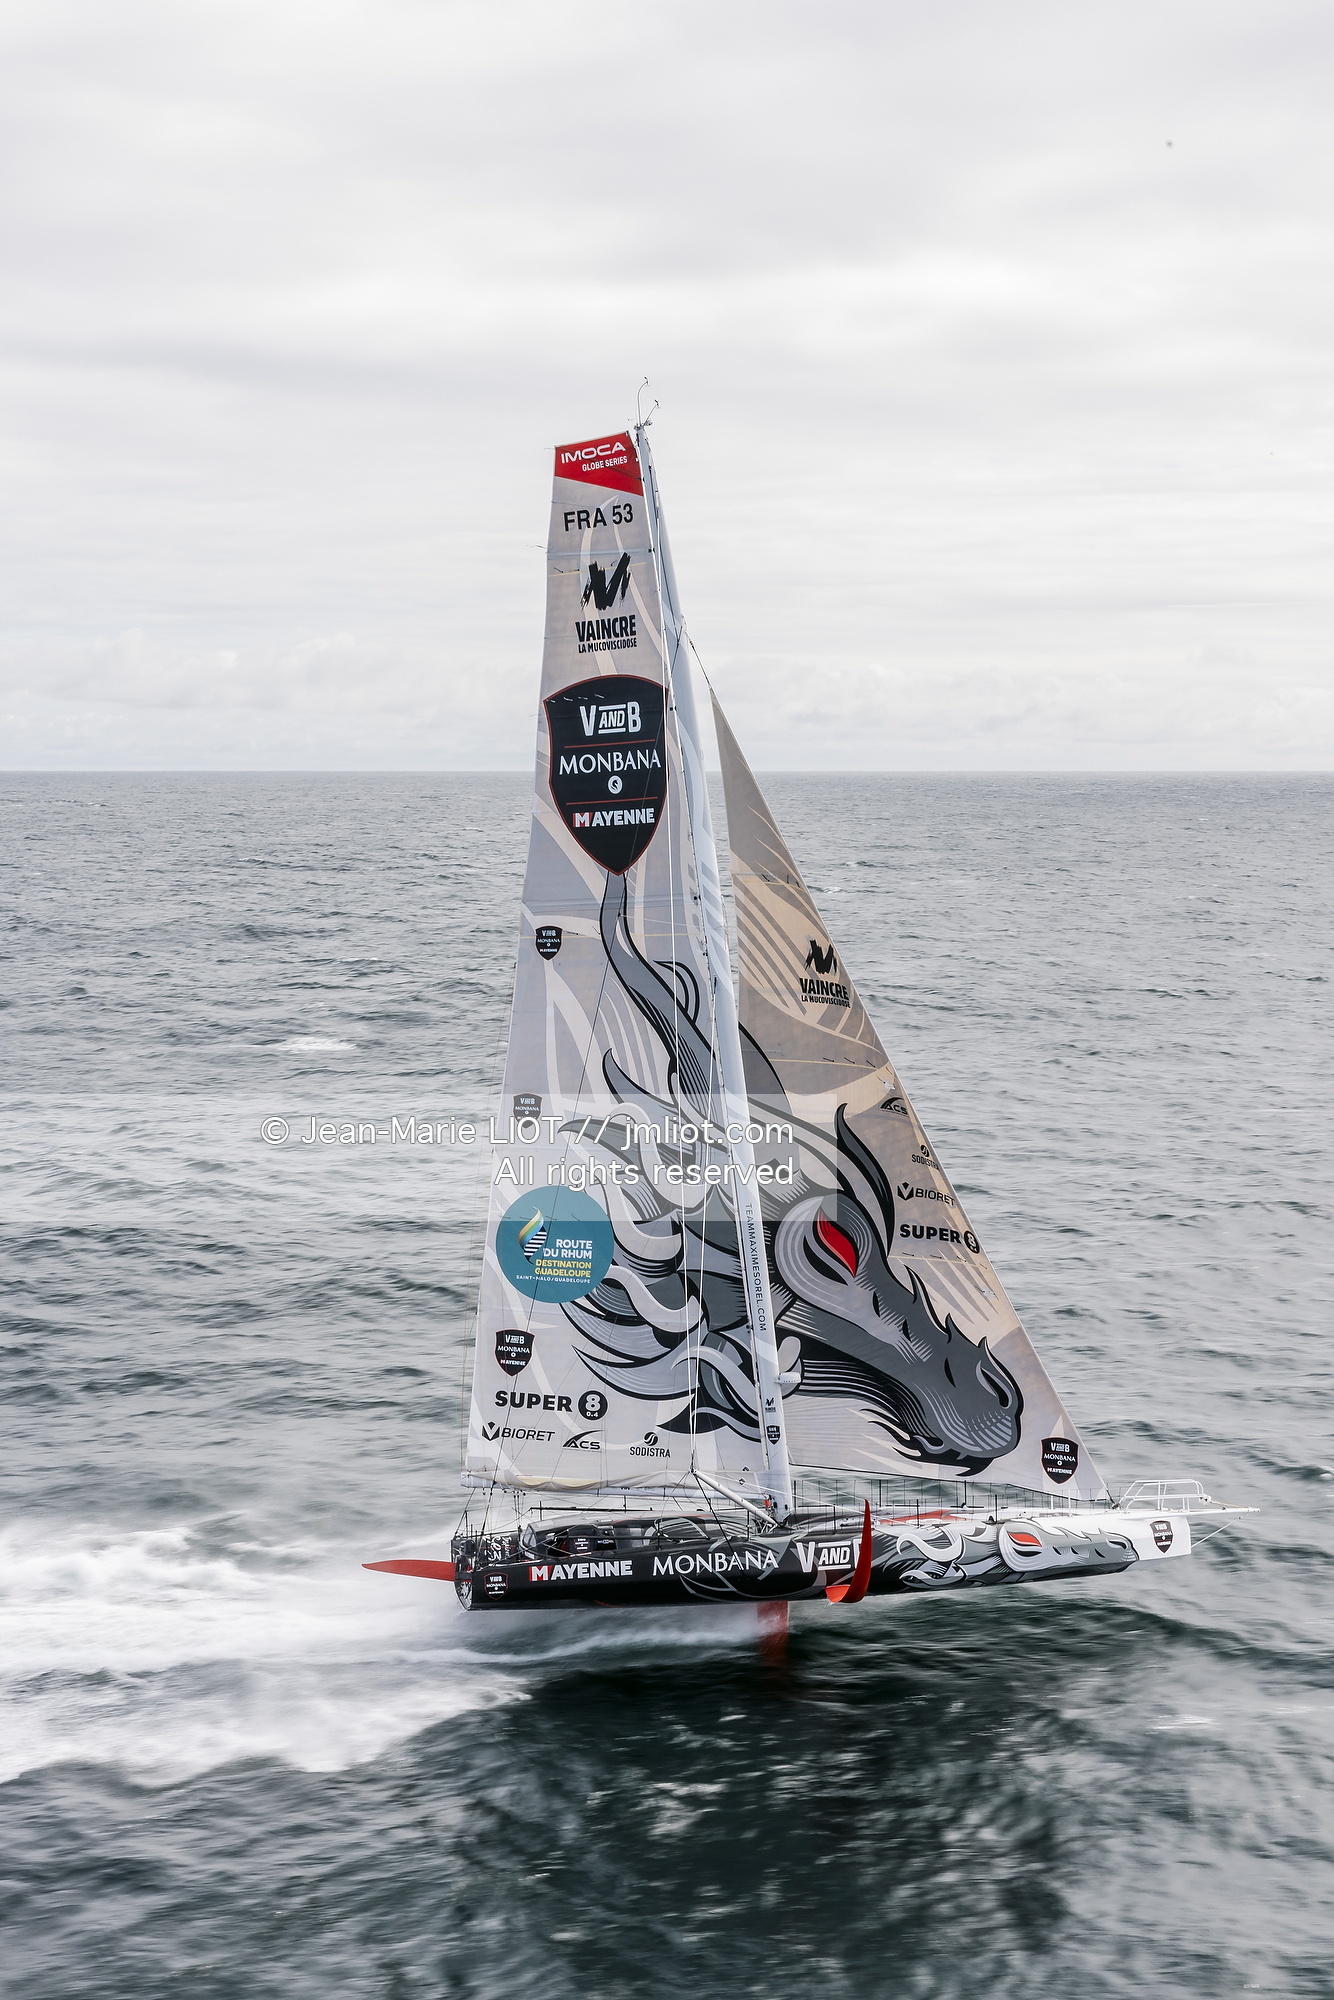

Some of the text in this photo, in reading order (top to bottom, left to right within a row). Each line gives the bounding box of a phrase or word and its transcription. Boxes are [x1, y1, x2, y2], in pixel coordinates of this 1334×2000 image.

[561, 441, 626, 464] IMOCA
[582, 455, 628, 472] GLOBE SERIES
[563, 503, 634, 532] FRA 53
[575, 614, 637, 642] VAINCRE
[578, 637, 638, 654] LA MUCOVISCIDOSE
[559, 748, 662, 775] MONBANA
[572, 807, 656, 828] MAYENNE
[799, 977, 849, 1000] VAINCRE
[801, 994, 851, 1009] LA MUCOVISCIDOSE
[881, 1101, 909, 1116] ACS
[915, 1187, 955, 1206] BIORET
[900, 1223, 962, 1245] SUPER
[556, 1238, 593, 1249] ROUTE
[543, 1247, 592, 1260] DU RHUM
[534, 1267, 591, 1278] GUADELOUPE
[535, 1258, 592, 1270] DESTINATION
[745, 1203, 767, 1332] TEAMMAXIMESOREL.COM
[497, 1345, 530, 1354] MONBANA
[494, 1390, 573, 1413] SUPER
[501, 1427, 556, 1442] BIORET
[562, 1438, 601, 1450] ACS
[629, 1446, 671, 1458] SODISTRA
[1043, 1453, 1076, 1462] MONBANA
[529, 1560, 633, 1582] MAYENNE
[652, 1549, 779, 1577] MONBANA
